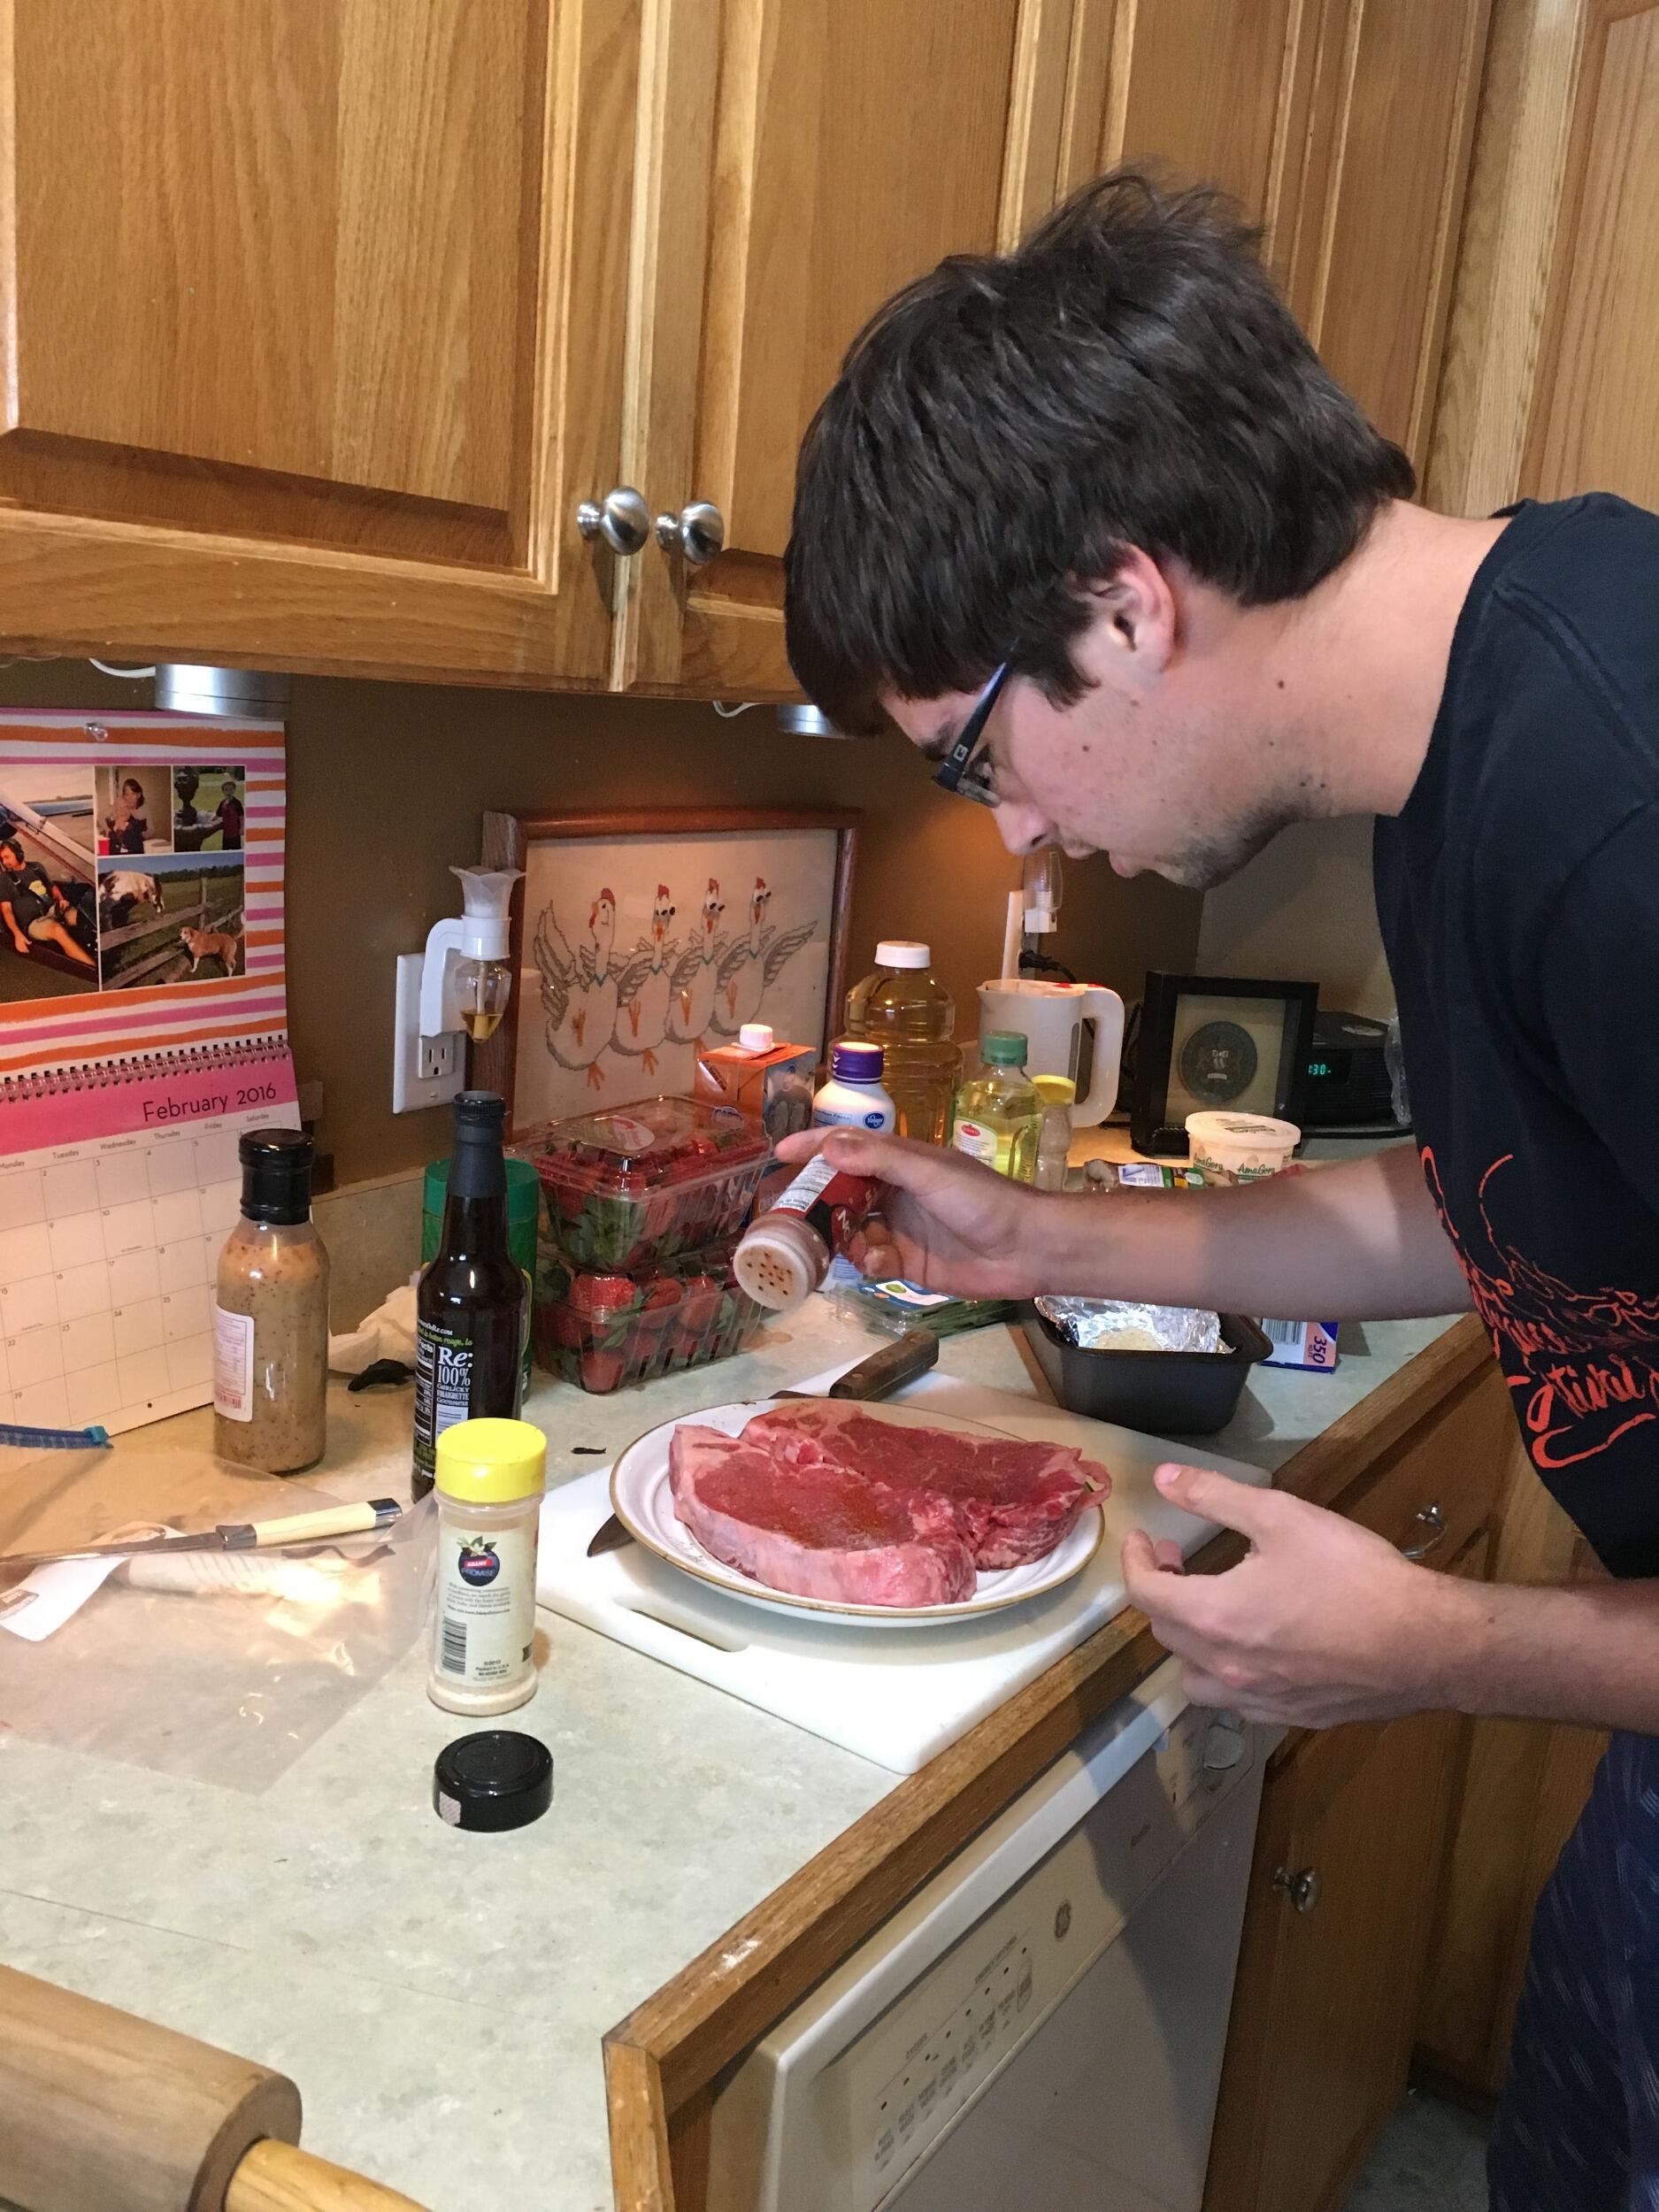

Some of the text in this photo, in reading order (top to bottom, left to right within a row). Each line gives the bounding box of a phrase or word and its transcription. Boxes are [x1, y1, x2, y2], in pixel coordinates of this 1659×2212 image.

[142, 1082, 276, 1121] February 2016
[51, 1149, 80, 1159] Tuesday
[100, 1139, 136, 1150] Wednesday
[154, 1130, 180, 1141] Thursday
[246, 1112, 269, 1122] Saturday
[438, 1346, 473, 1368] Re:
[1312, 1335, 1327, 1364] 350
[437, 1365, 471, 1386] 100%
[461, 1567, 495, 1577] PROMISE
